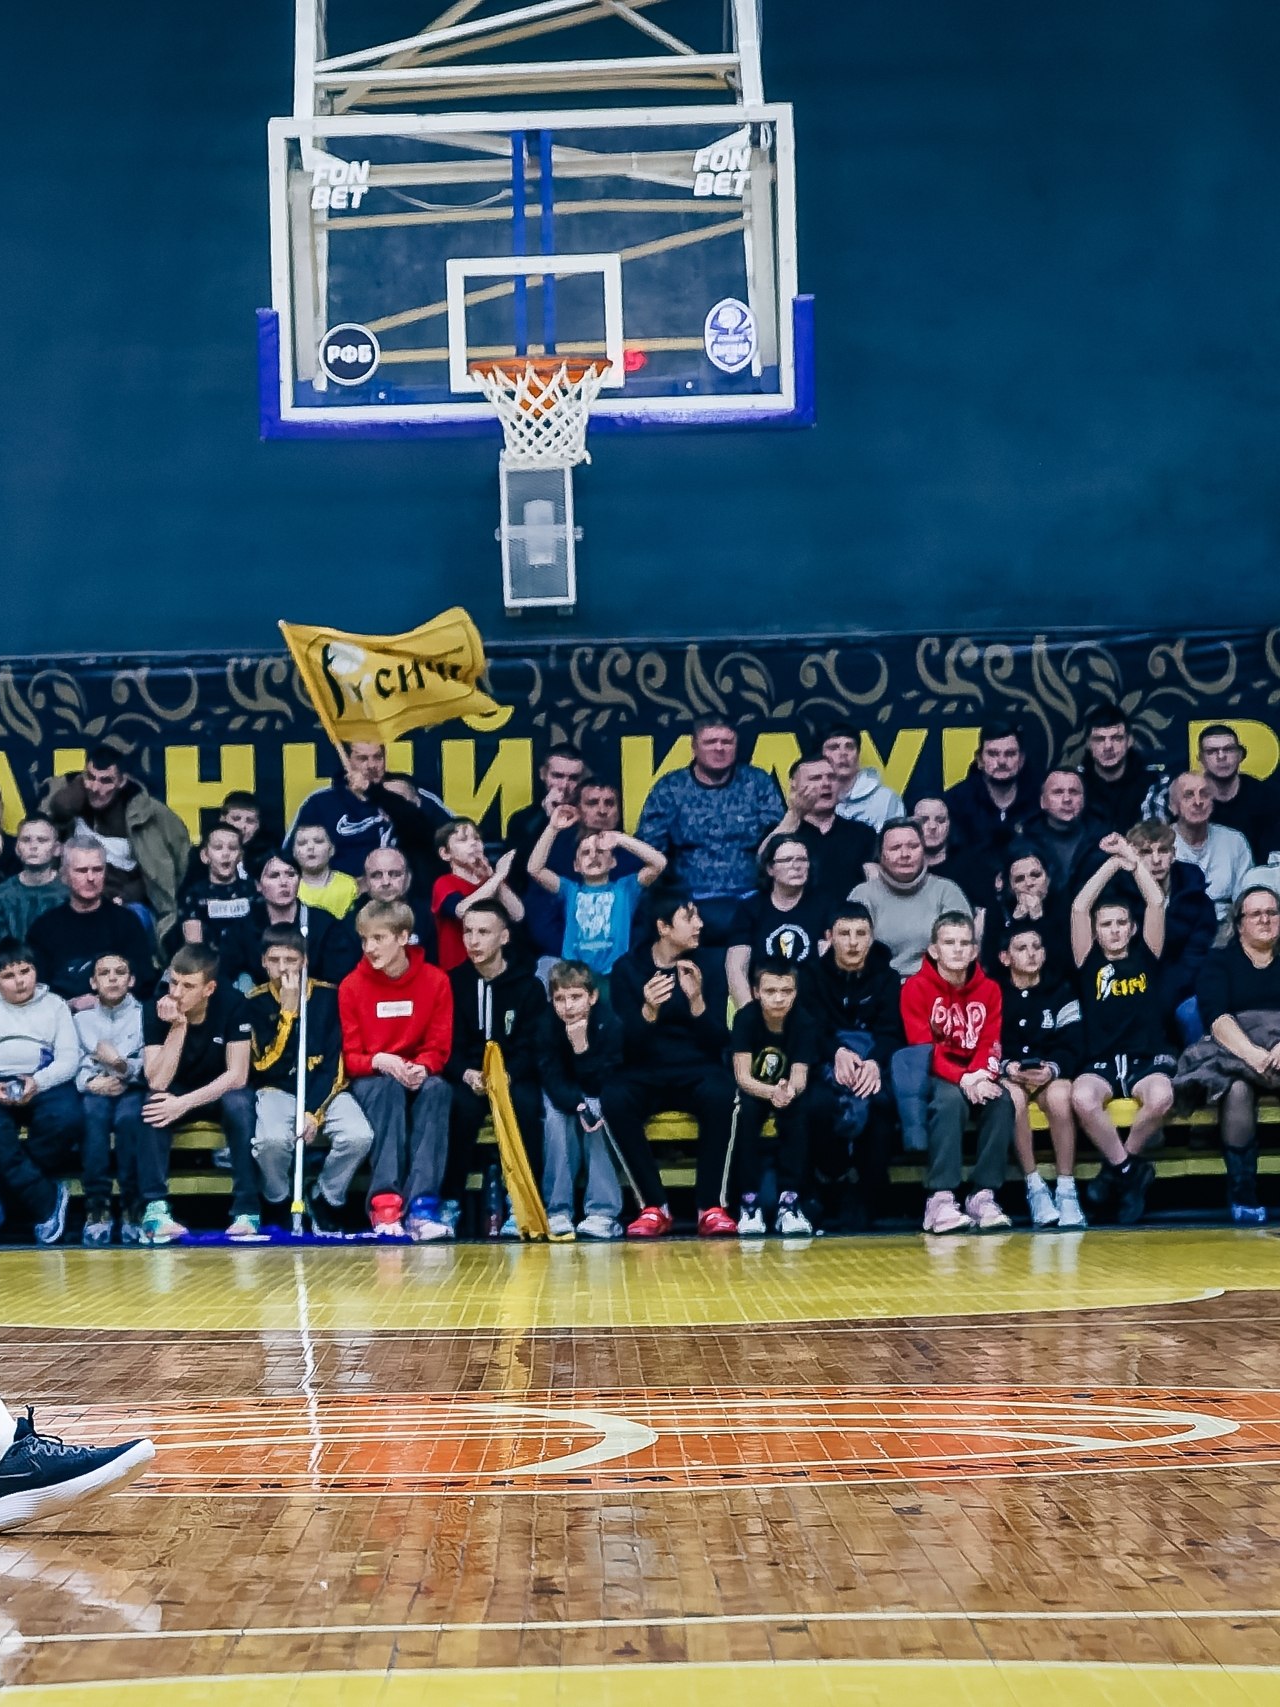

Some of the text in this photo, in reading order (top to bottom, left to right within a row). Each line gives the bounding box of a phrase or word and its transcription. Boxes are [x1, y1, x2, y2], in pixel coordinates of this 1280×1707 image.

[693, 147, 752, 172] FON
[313, 160, 370, 186] FON
[694, 171, 751, 196] BET
[311, 185, 369, 209] BET
[327, 344, 373, 364] РФБ
